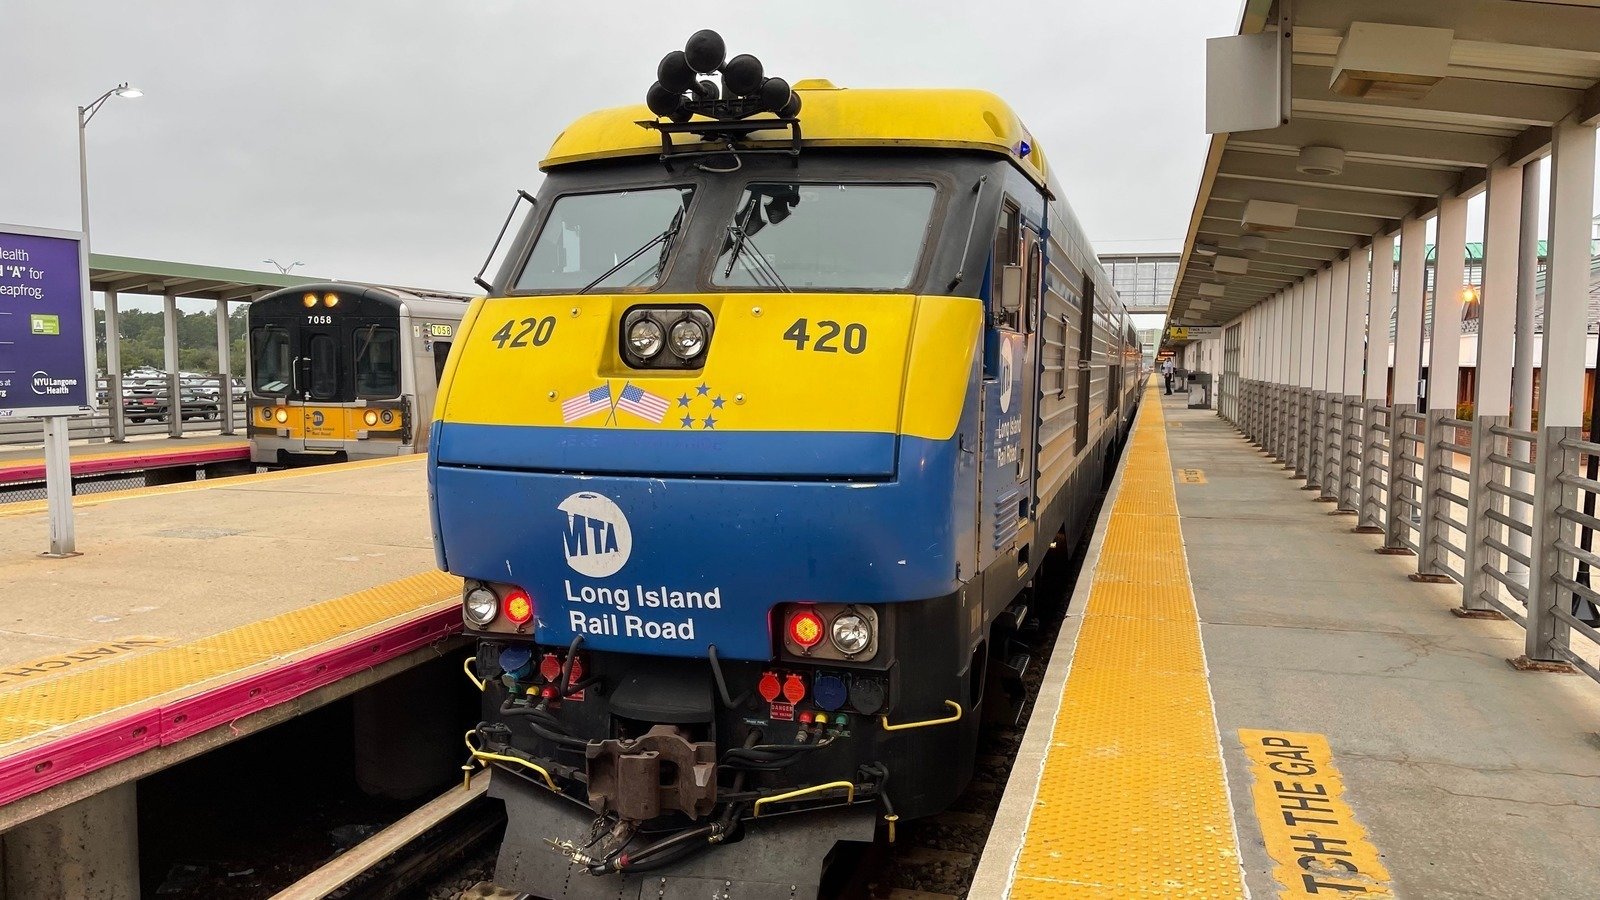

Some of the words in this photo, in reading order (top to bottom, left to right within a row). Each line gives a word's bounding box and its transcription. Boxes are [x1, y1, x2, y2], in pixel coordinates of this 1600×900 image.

[29, 267, 44, 280] for
[307, 316, 332, 325] 7058
[432, 325, 451, 336] 7058
[491, 315, 557, 349] 420
[783, 318, 868, 355] 420
[33, 377, 49, 386] NYU
[49, 378, 77, 388] Langone
[46, 386, 69, 395] Health
[561, 511, 619, 557] MTA
[564, 580, 631, 611] Long
[636, 585, 722, 609] Island
[569, 610, 618, 636] Rail
[624, 614, 695, 640] Road
[1, 640, 157, 676] WATCH
[1261, 736, 1318, 776] GAP
[1273, 780, 1339, 827] THE
